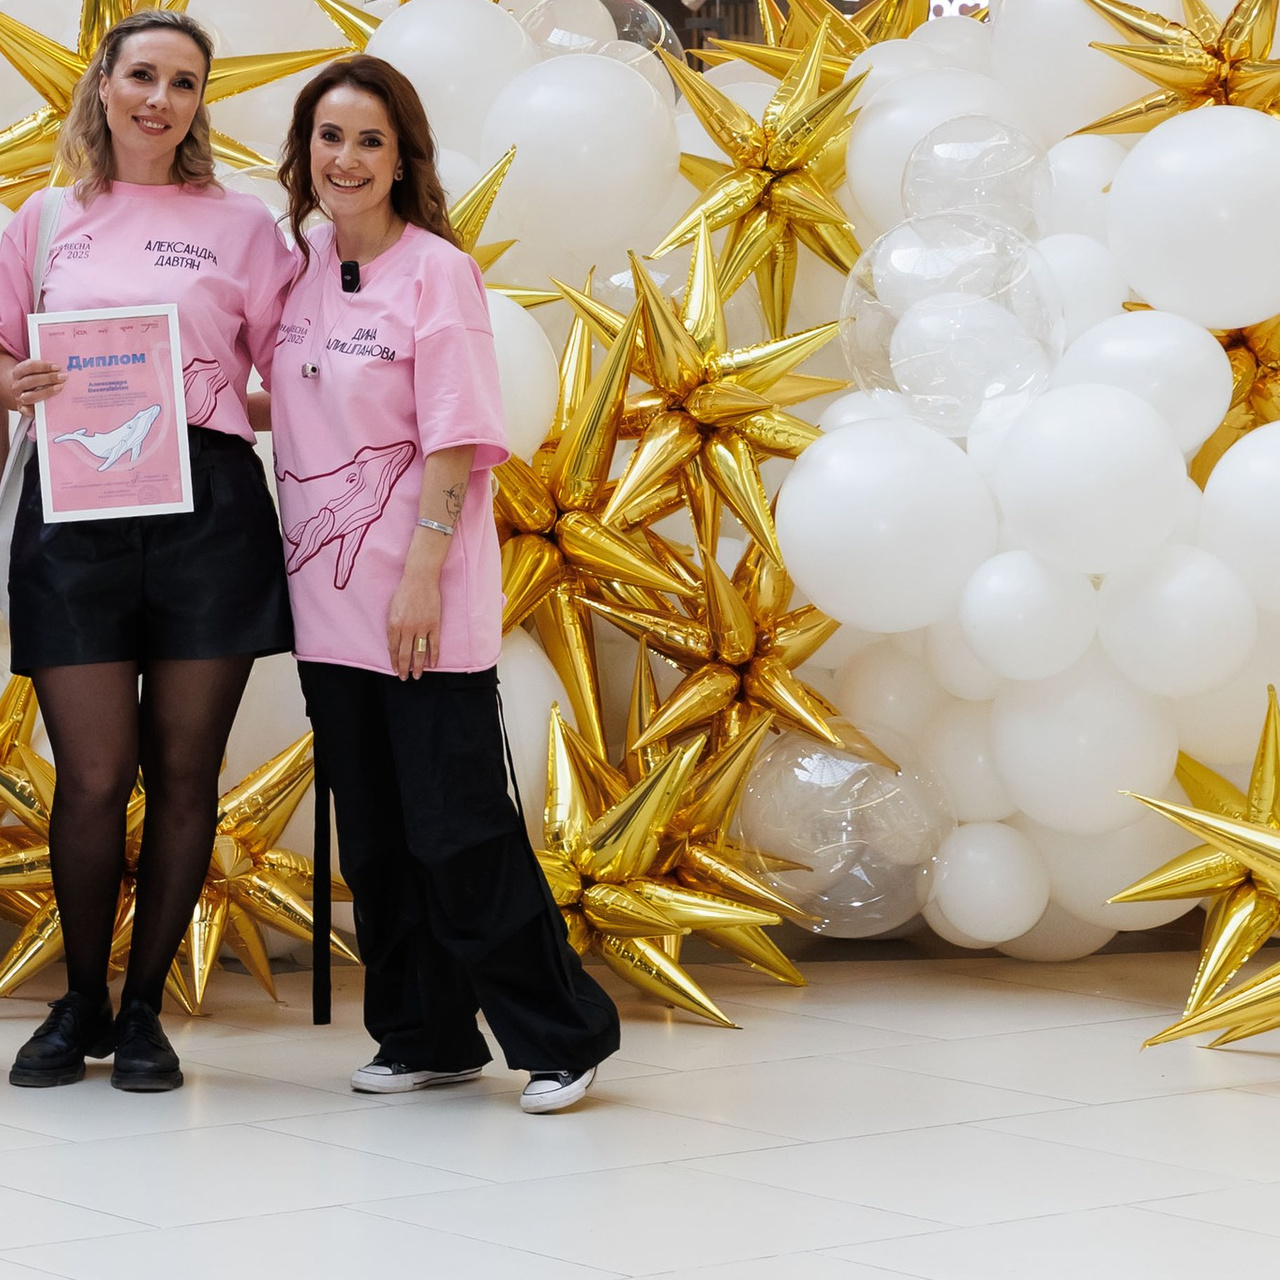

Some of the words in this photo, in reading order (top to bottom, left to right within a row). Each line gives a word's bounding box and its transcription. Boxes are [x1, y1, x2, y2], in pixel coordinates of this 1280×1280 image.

[64, 242, 91, 251] ВЕСНА
[144, 239, 218, 267] АЛЕКСАНДРА
[67, 250, 90, 259] 2025
[154, 255, 201, 271] ДАВТЯН
[351, 327, 377, 341] ДИНА
[67, 352, 146, 372] Диплом
